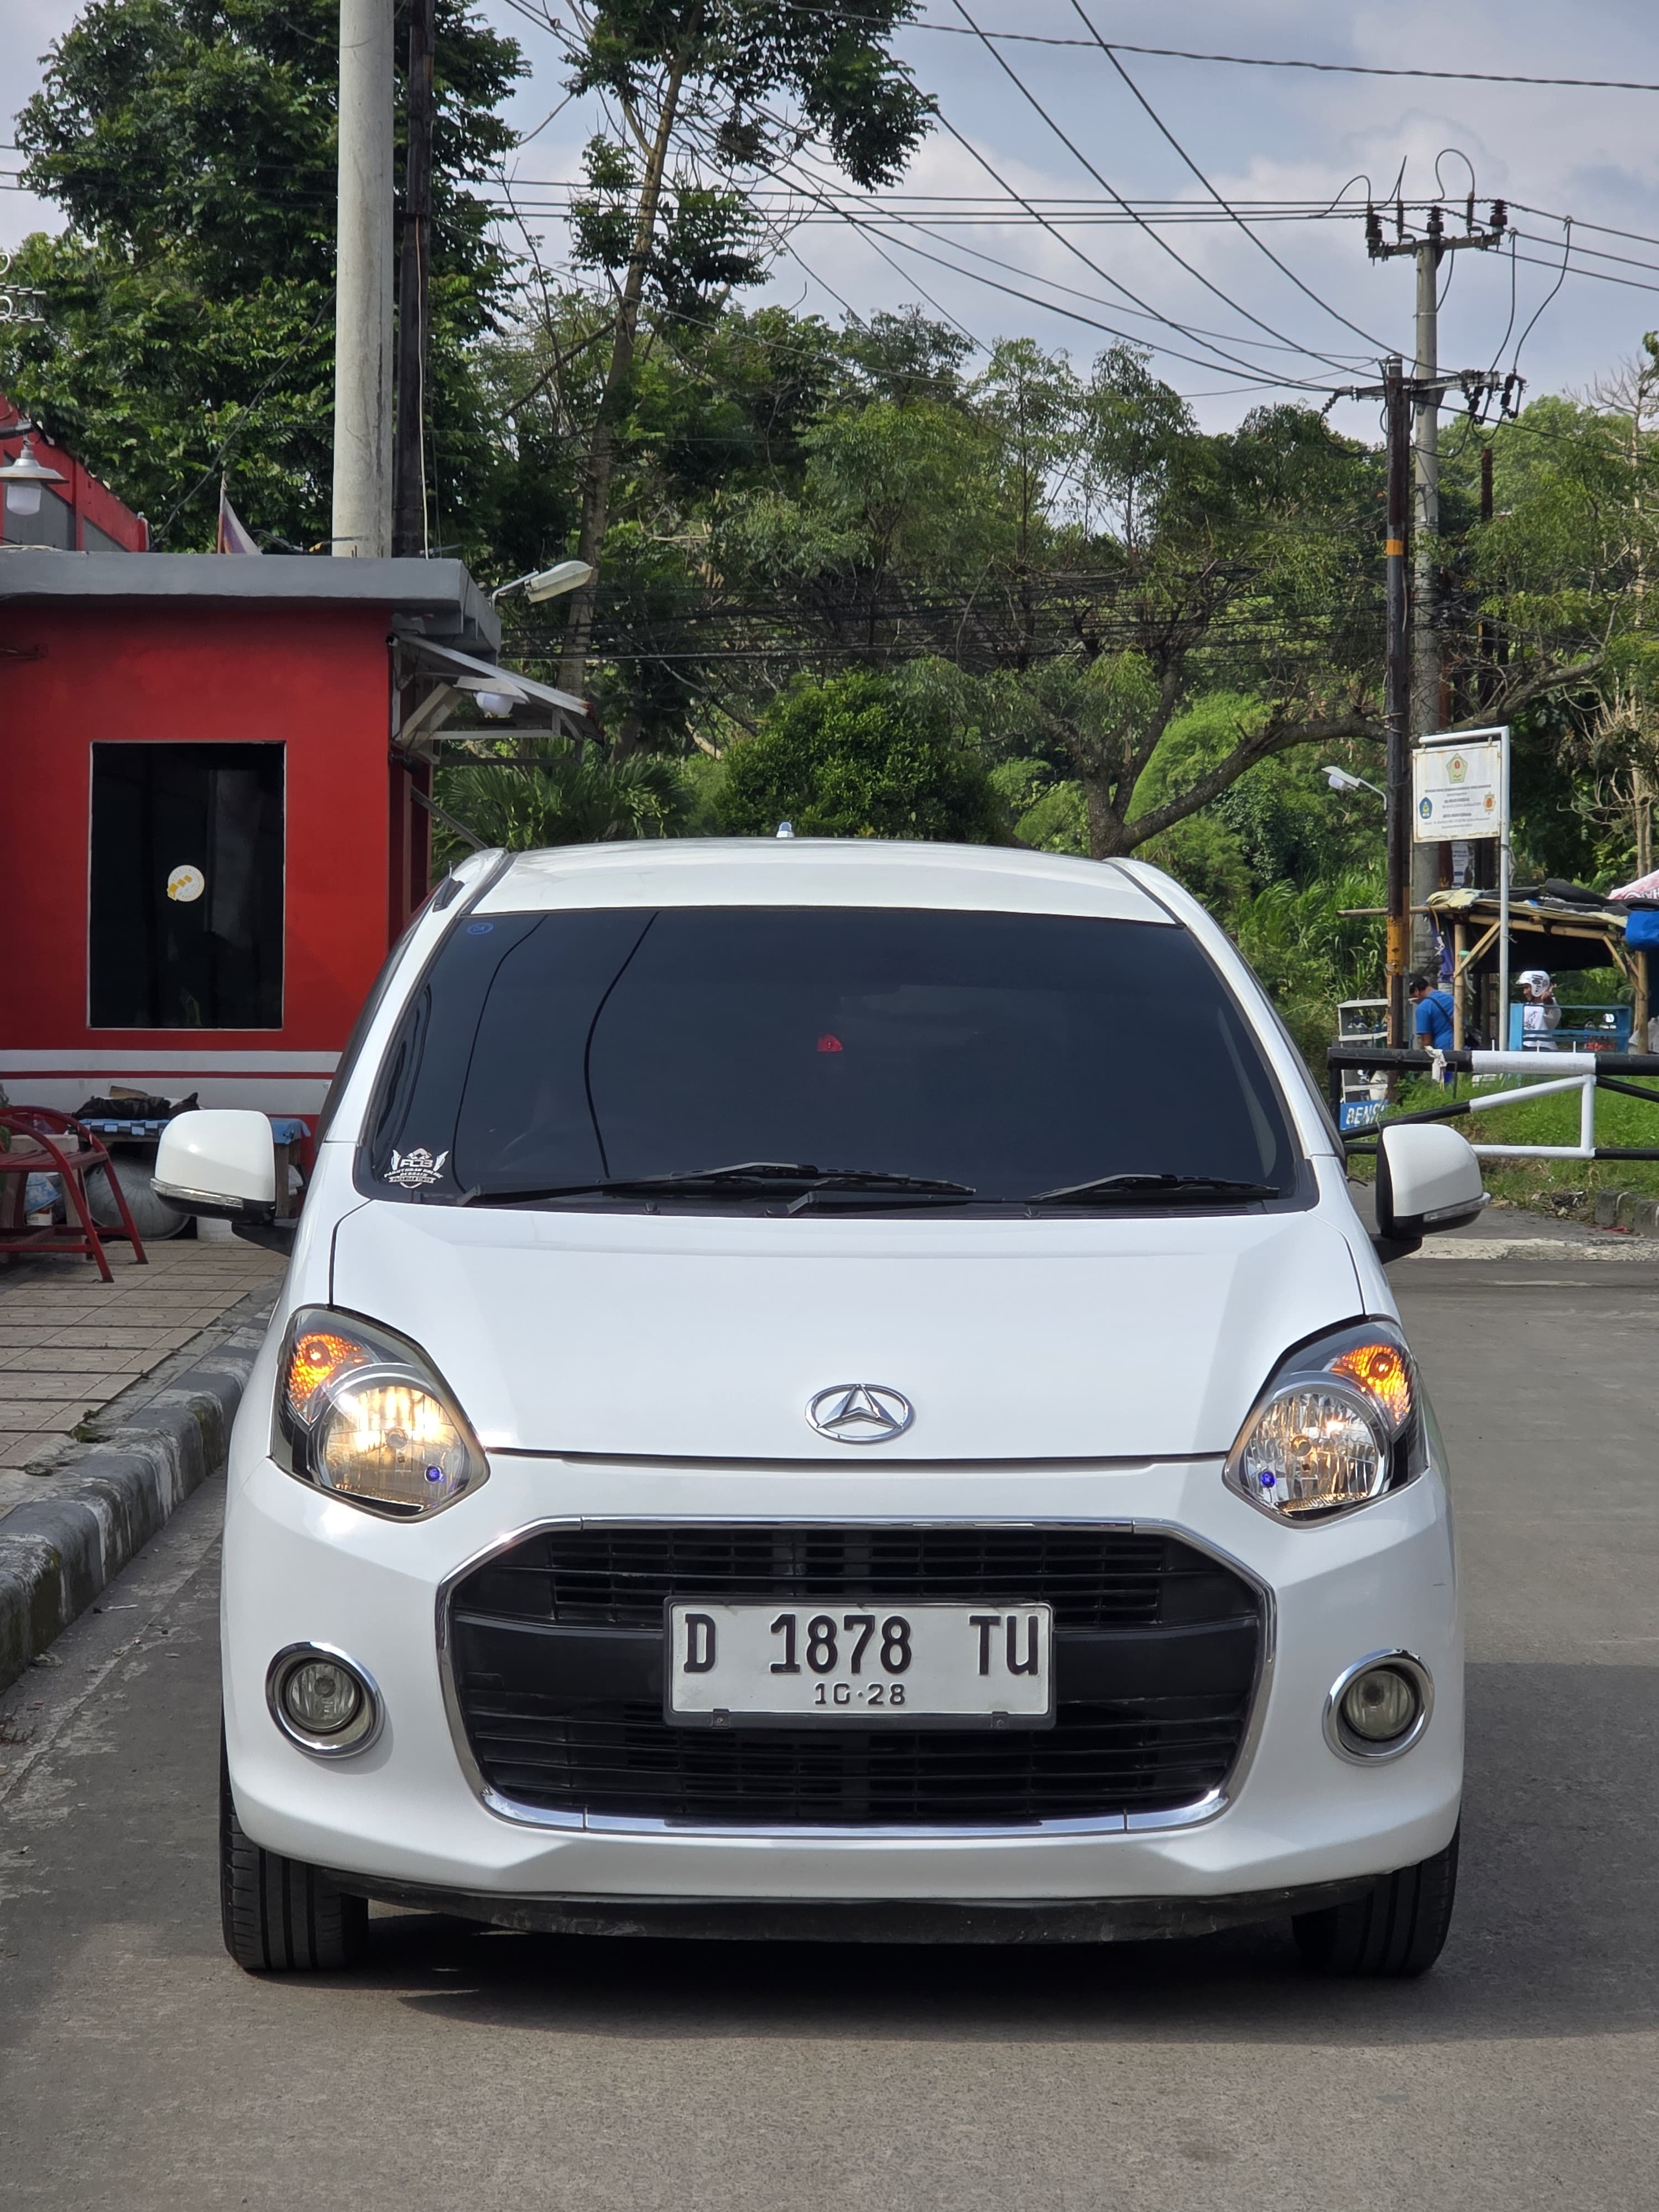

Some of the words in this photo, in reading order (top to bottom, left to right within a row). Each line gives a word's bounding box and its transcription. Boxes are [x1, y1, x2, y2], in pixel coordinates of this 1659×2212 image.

[684, 1614, 716, 1673] D
[770, 1614, 912, 1674] 1878
[969, 1615, 1039, 1676] TU
